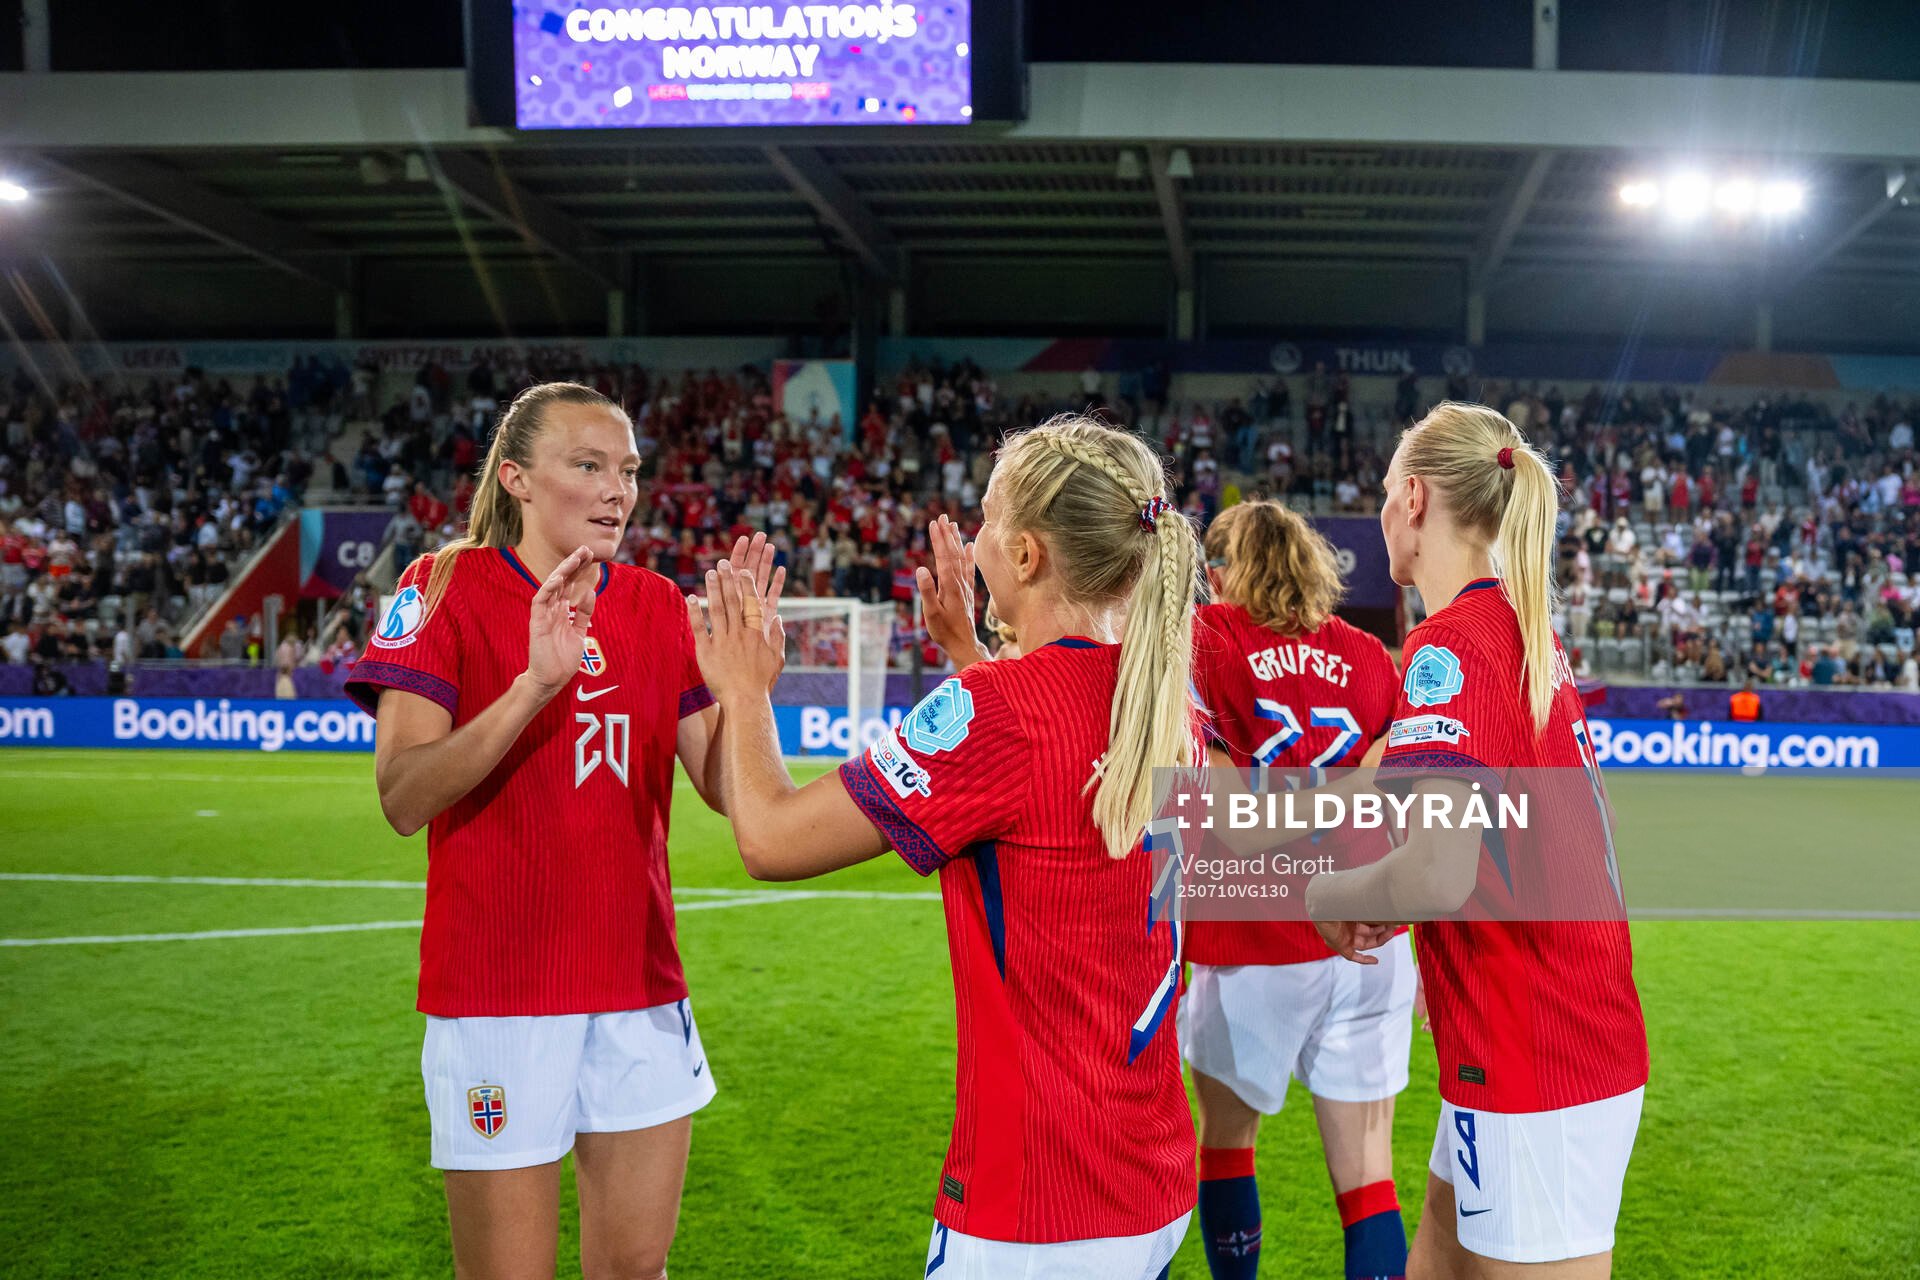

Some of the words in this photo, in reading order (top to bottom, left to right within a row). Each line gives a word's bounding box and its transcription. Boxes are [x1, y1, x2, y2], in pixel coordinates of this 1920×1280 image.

[565, 4, 917, 42] CONGRATULATIONS
[662, 44, 820, 79] NORWAY
[1335, 347, 1414, 373] THUN
[337, 541, 375, 568] C8
[1247, 644, 1352, 688] GRUPSET
[575, 713, 630, 789] 20
[1590, 719, 1879, 777] Booking.com
[1454, 1110, 1481, 1192] 9
